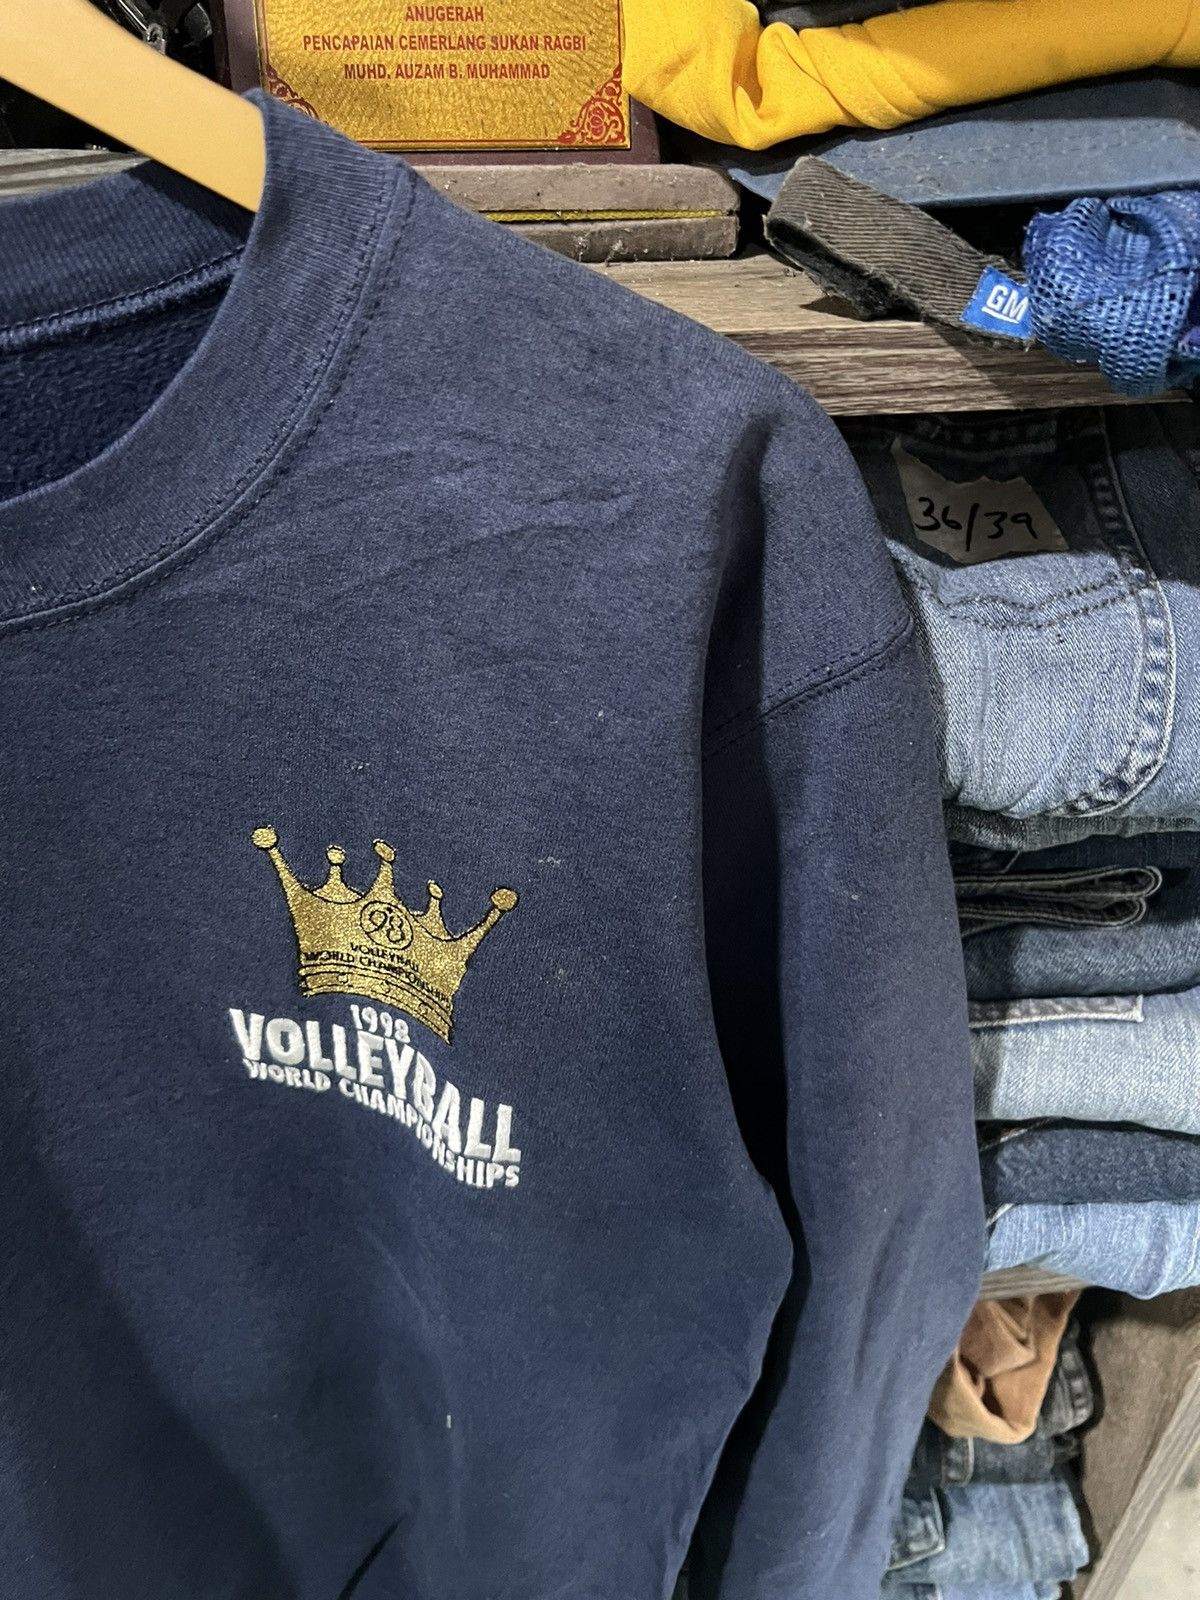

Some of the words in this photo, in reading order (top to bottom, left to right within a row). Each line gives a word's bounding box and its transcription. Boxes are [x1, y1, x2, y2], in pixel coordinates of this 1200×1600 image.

[405, 6, 484, 22] ANUGERAH
[303, 35, 392, 51] PENCAPAIAN
[400, 35, 486, 51] CEMERLANG
[491, 35, 538, 51] SUKAN
[543, 35, 586, 51] RAGBI
[344, 64, 390, 80] MUHD.
[395, 64, 444, 80] AUZAM
[449, 64, 462, 80] B.
[466, 64, 550, 80] MUHAMMAD
[985, 284, 1029, 323] GM
[915, 496, 1037, 552] 36/39
[350, 1004, 410, 1043] 1998
[229, 1007, 521, 1162] VOLLEYBALL
[243, 1058, 331, 1092] WORLD
[339, 1077, 520, 1189] CHAMPIONSHIPS
